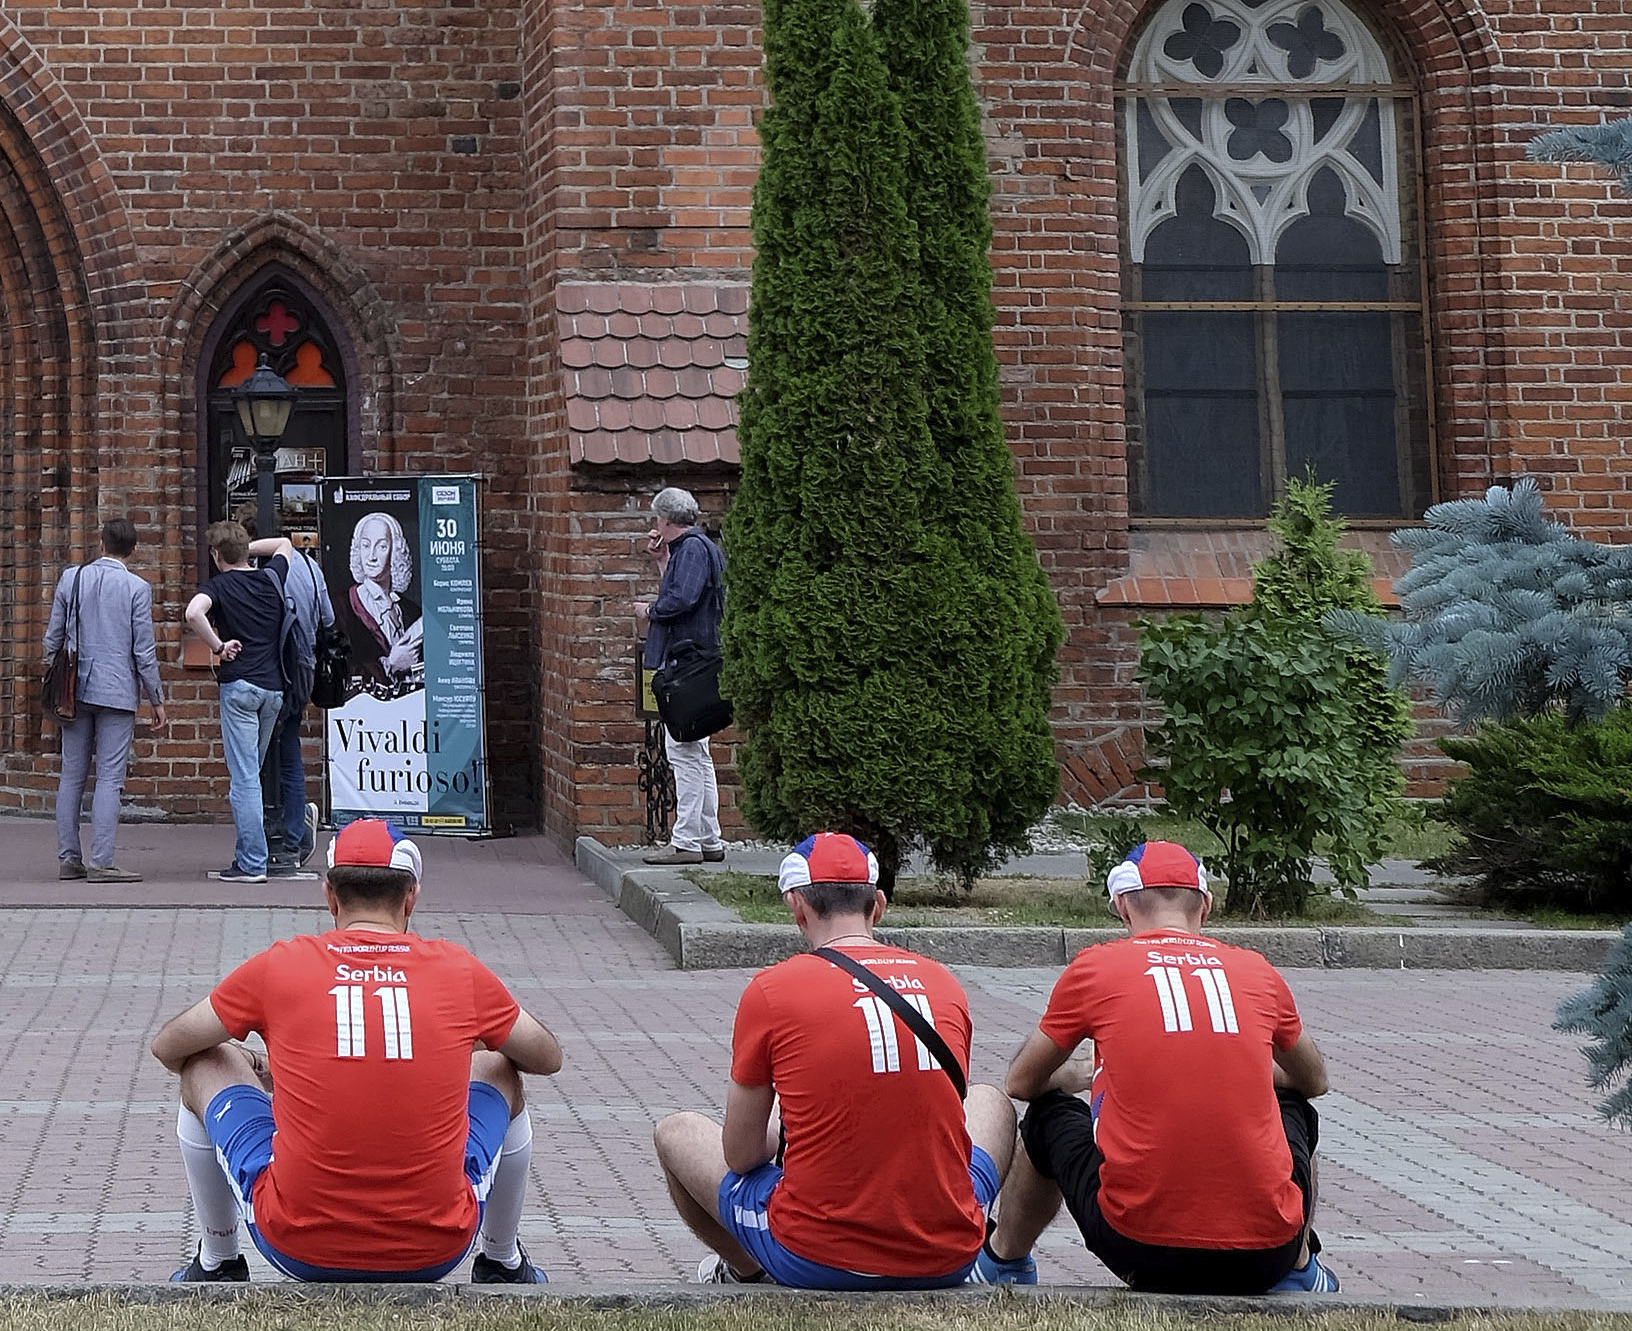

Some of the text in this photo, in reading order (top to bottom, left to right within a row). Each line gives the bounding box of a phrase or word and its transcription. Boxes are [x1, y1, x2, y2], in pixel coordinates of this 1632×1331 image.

[436, 519, 457, 538] 30
[430, 541, 465, 555] ИЮНЯ
[334, 718, 441, 753] Vivaldi
[356, 757, 479, 794] furioso!
[1147, 951, 1223, 966] Serbia
[335, 964, 407, 983] Serbia
[1144, 966, 1240, 1034] 11
[328, 985, 413, 1060] 11
